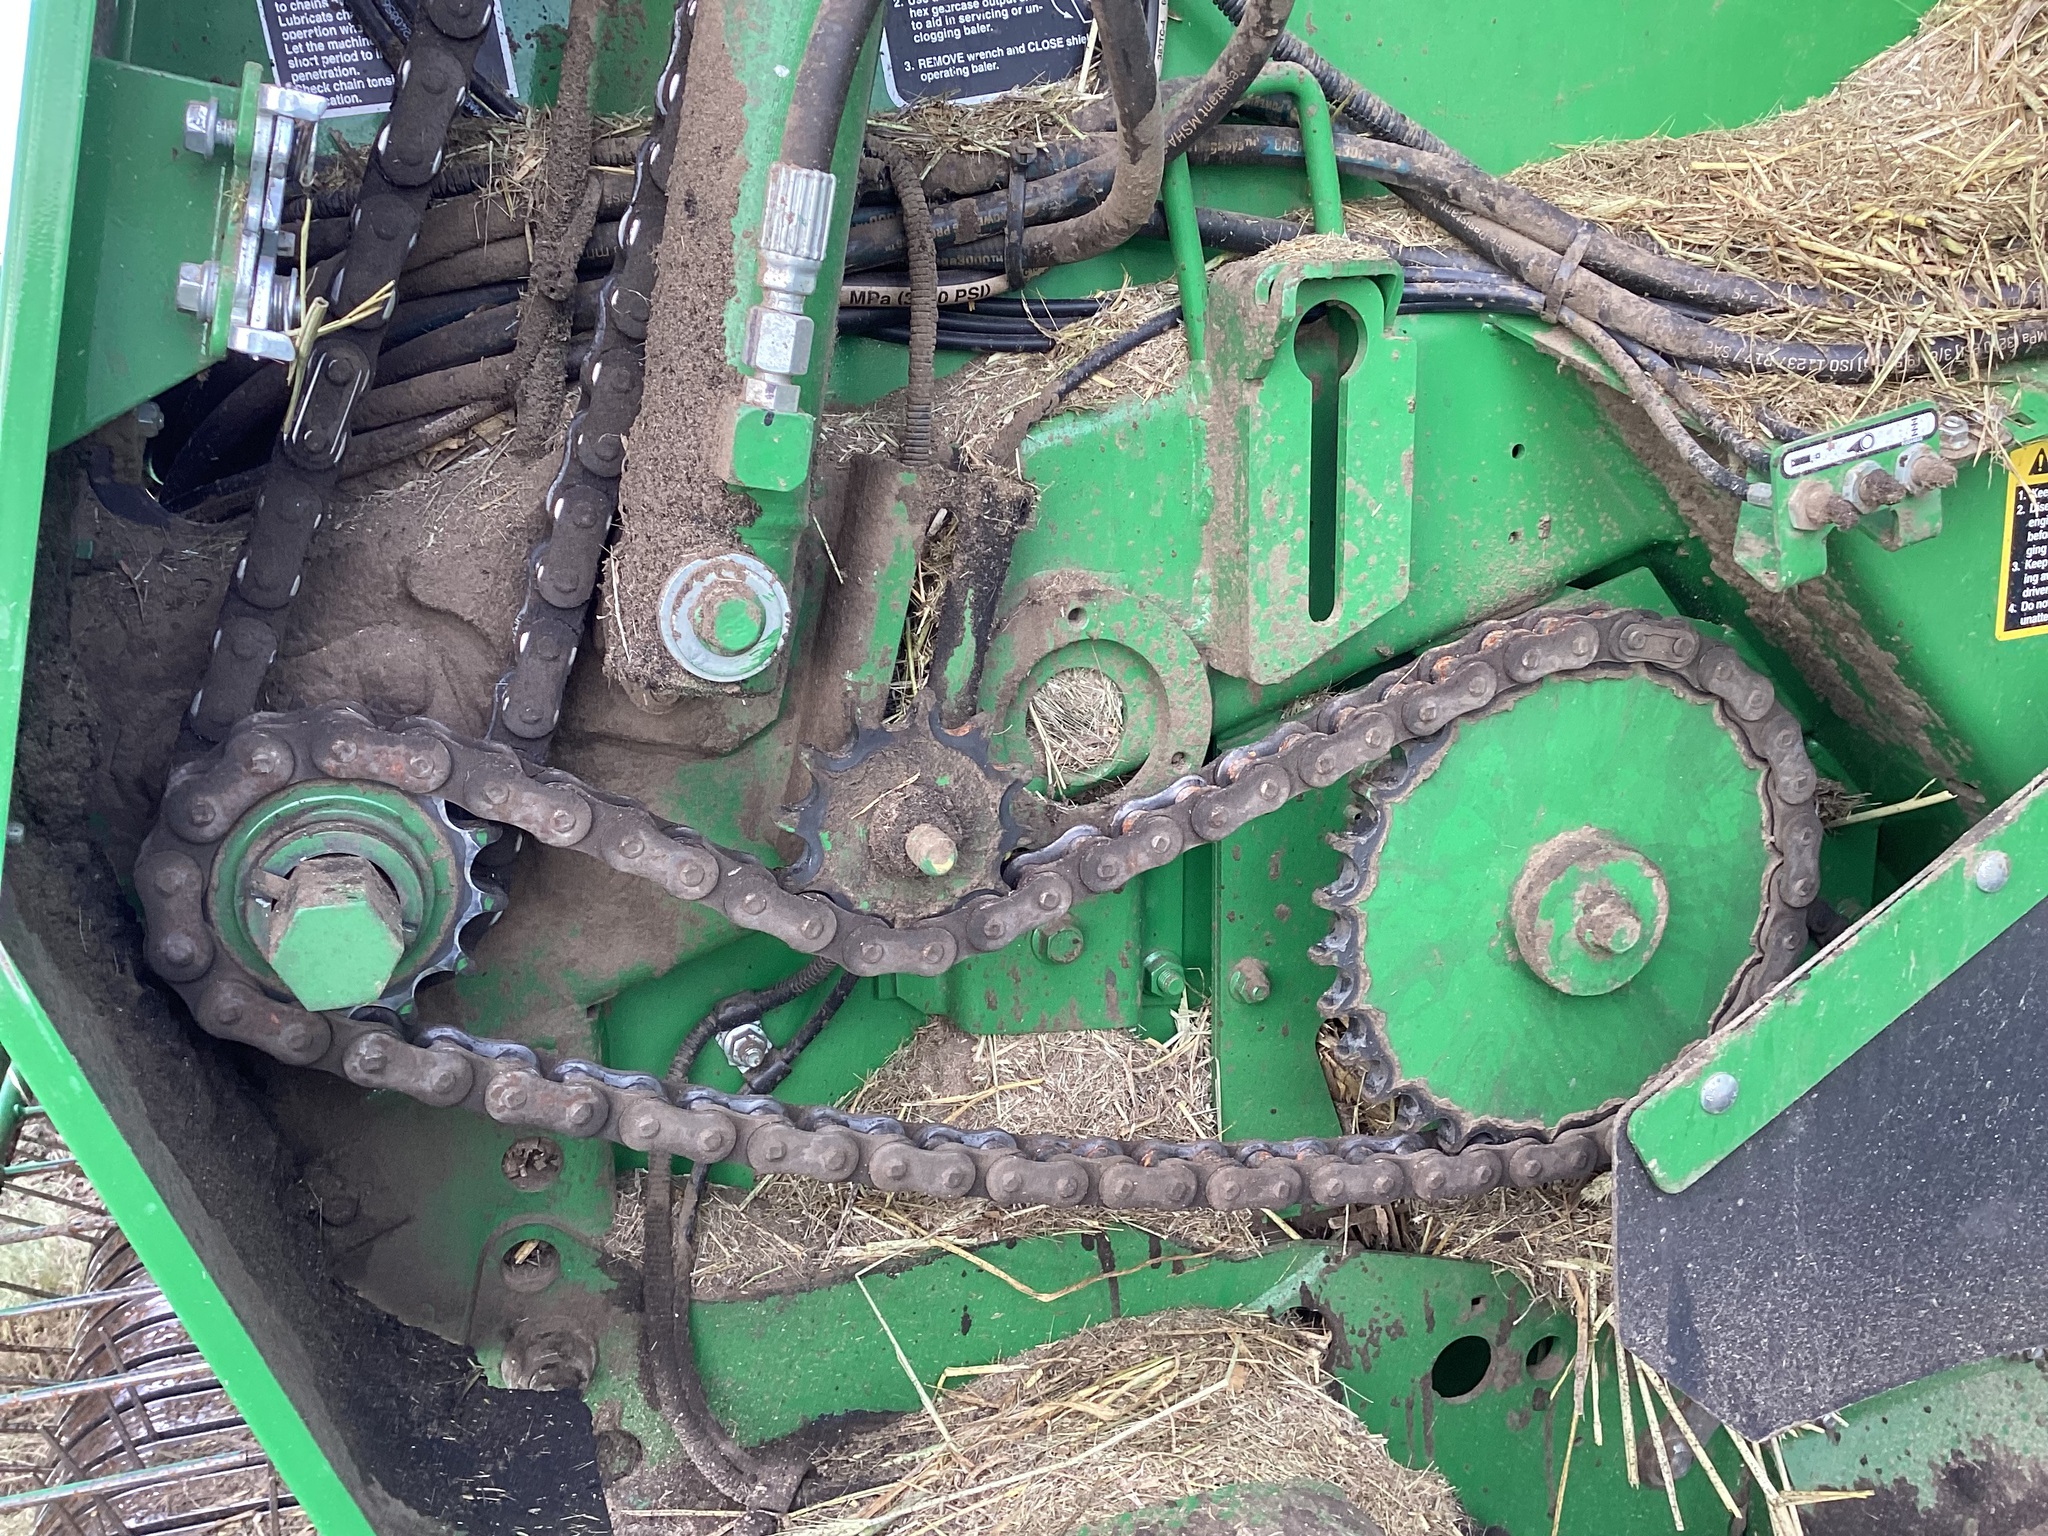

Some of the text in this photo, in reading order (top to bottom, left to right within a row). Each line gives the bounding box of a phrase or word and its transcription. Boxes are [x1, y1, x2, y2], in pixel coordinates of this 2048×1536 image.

[274, 1, 287, 13] to
[909, 6, 930, 18] hex
[931, 1, 980, 17] gearcase
[277, 11, 334, 28] Lubricate
[911, 3, 1044, 31] to aid in servicing or un-
[281, 25, 337, 42] operation
[913, 22, 994, 44] clogging baler.
[284, 41, 305, 55] Let
[305, 39, 325, 53] the
[903, 60, 915, 72] 3.
[917, 52, 965, 70] REMOVE
[966, 47, 1005, 62] wrench
[1006, 43, 1026, 56] and
[1027, 37, 1065, 53] CLOSE
[287, 55, 320, 70] short
[321, 49, 360, 68] period
[360, 49, 374, 61] to
[291, 65, 361, 84] penetration.
[920, 60, 1000, 83] operating baler.
[332, 78, 366, 92] chain
[849, 290, 891, 306] MPa
[955, 283, 992, 304] PSI)
[1829, 357, 1854, 372] ISO
[2018, 490, 2027, 501] 1.
[2016, 504, 2026, 516] 2.
[2011, 559, 2048, 572] 3. Keep
[2023, 573, 2039, 585] ing
[2008, 603, 2018, 614] 4.
[2021, 600, 2035, 612] Do
